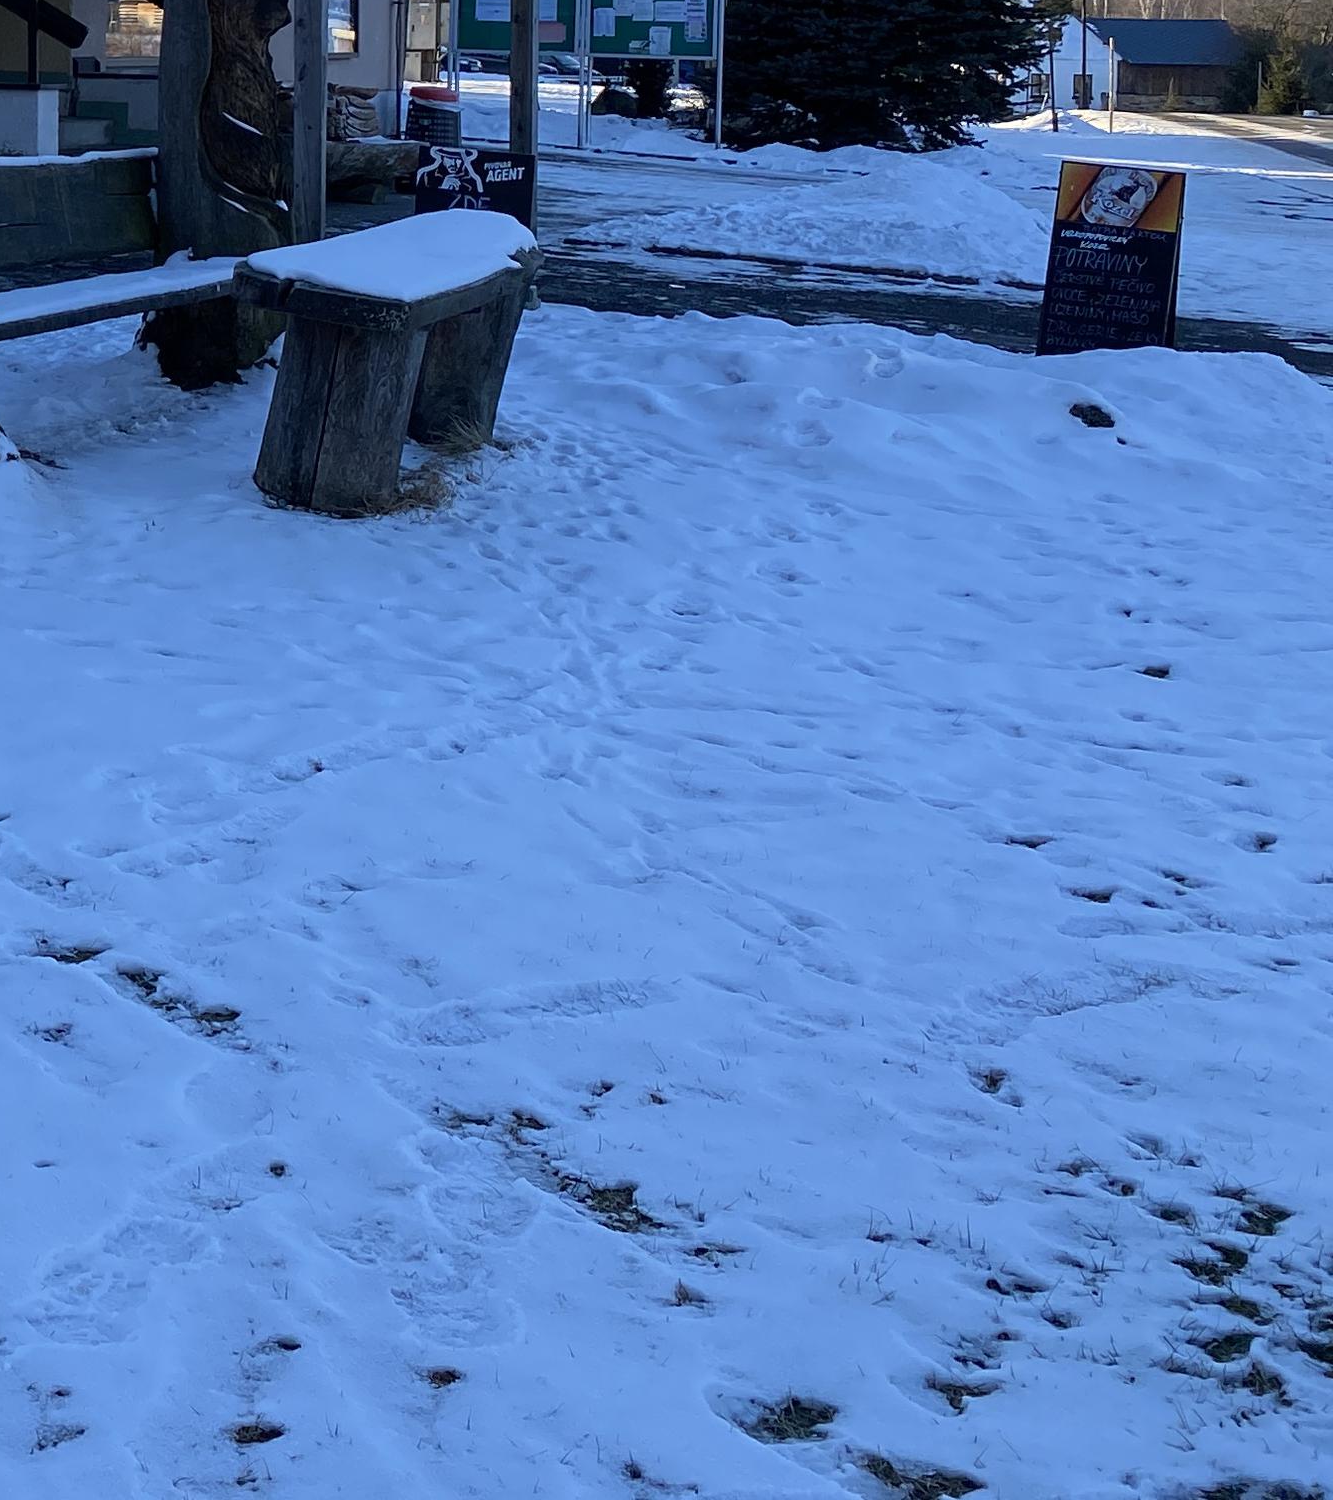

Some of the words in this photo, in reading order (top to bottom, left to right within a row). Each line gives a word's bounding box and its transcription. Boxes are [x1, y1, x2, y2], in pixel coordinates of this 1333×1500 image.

[486, 167, 526, 183] AGENT
[1091, 191, 1137, 220] Kozel
[1053, 245, 1148, 276] POTRAVINY
